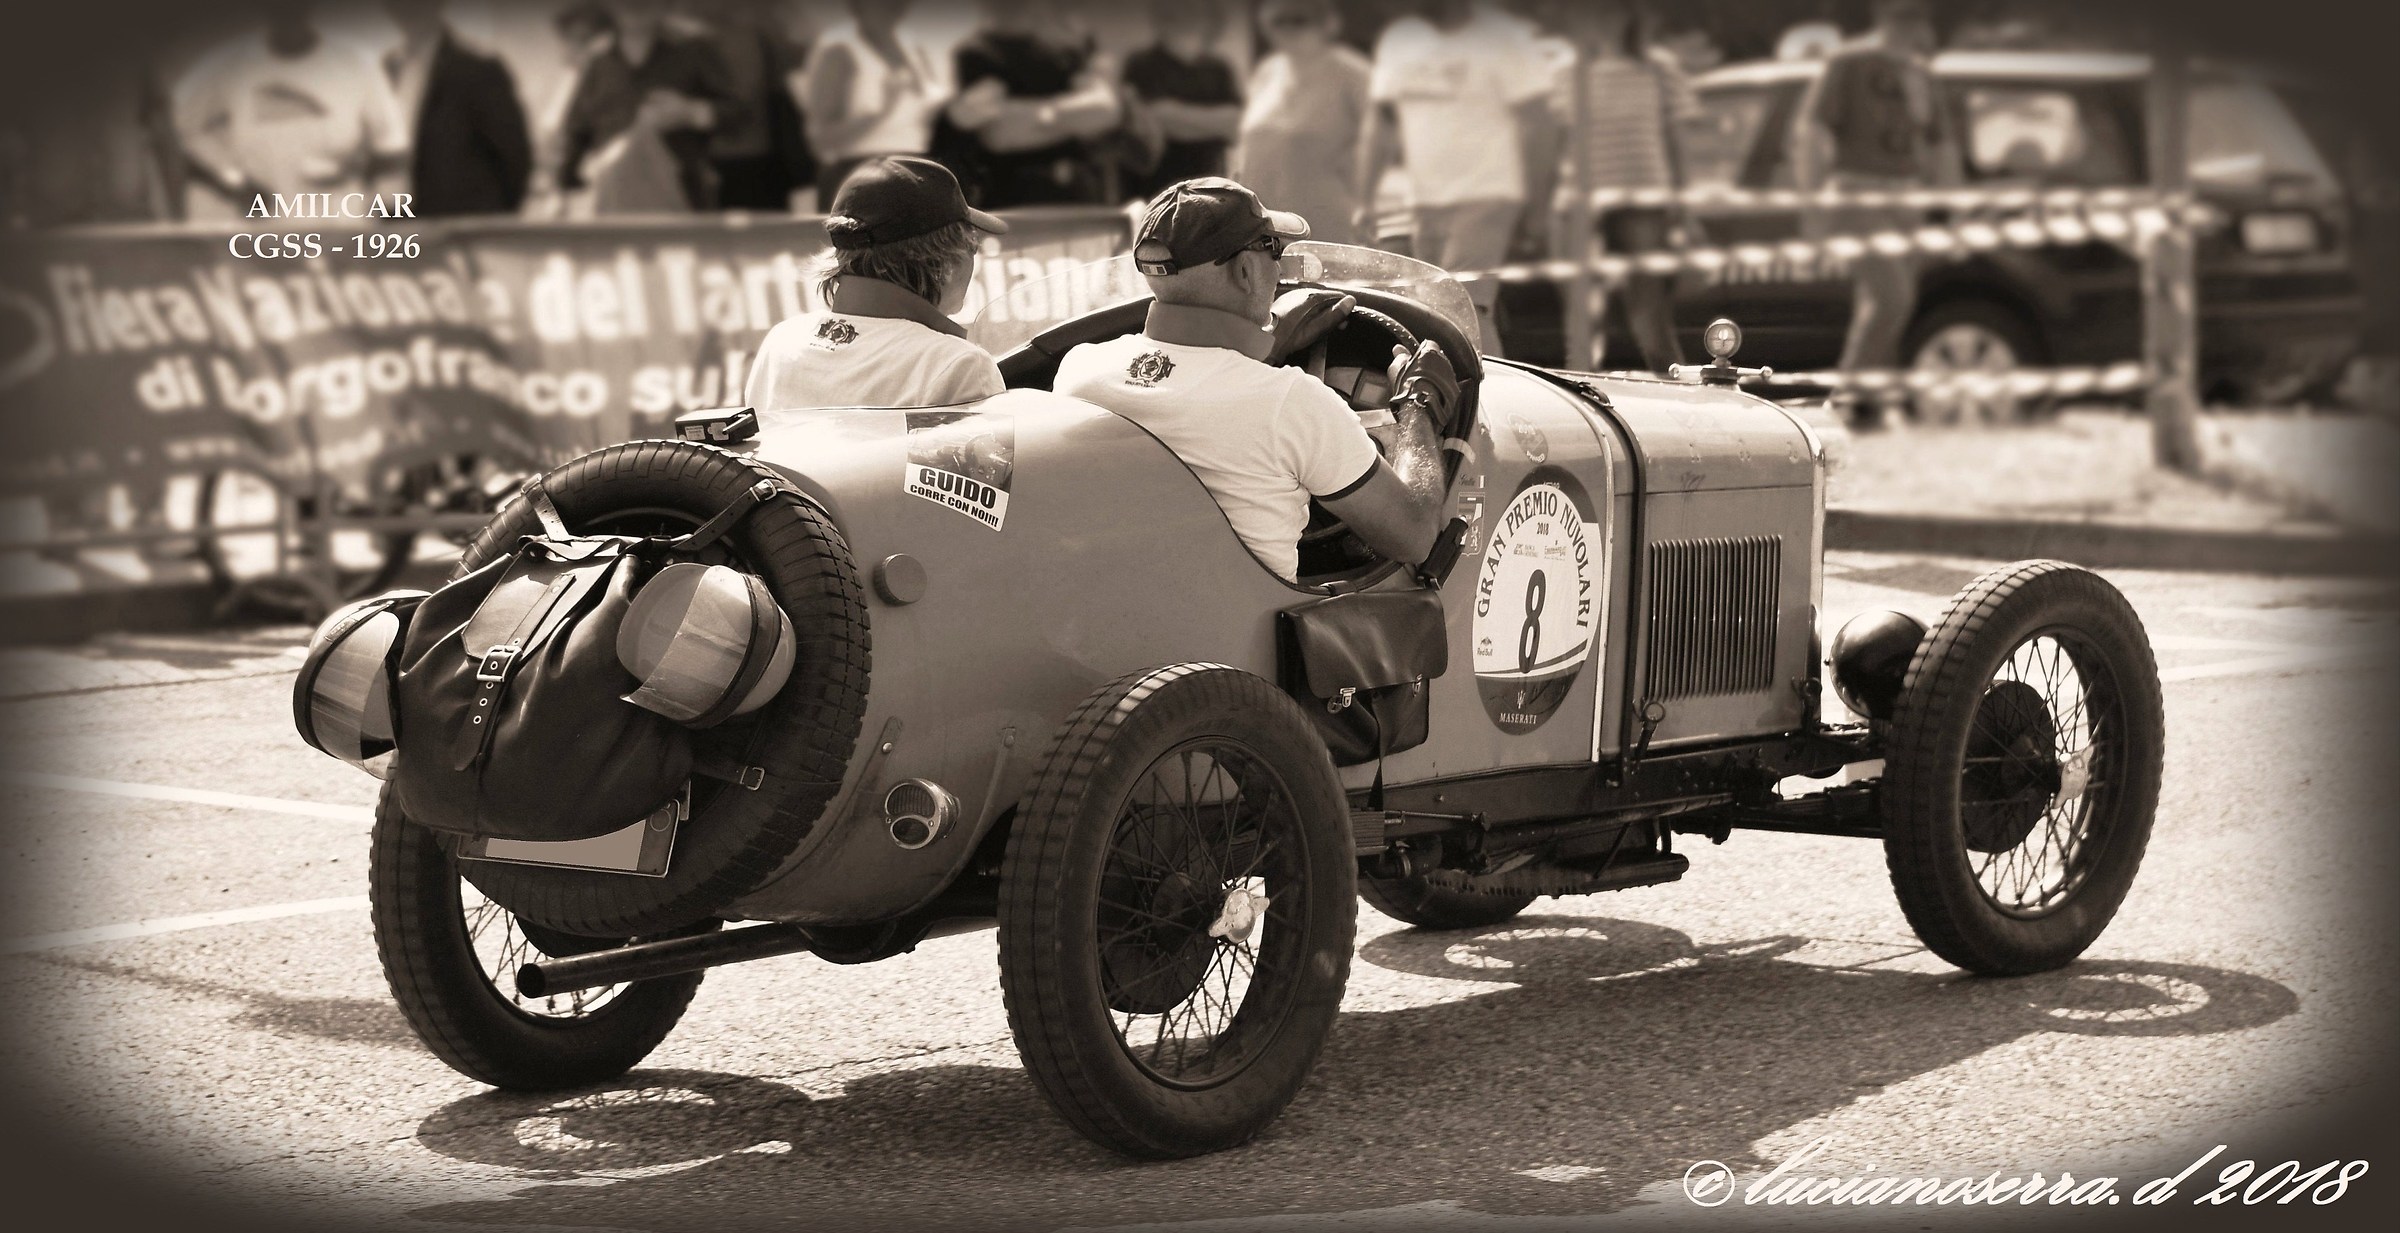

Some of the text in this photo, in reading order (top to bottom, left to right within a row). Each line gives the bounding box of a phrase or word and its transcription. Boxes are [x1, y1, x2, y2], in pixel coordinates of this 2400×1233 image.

[192, 252, 515, 352] Nazionae
[530, 249, 648, 342] del
[137, 355, 208, 412] di
[910, 484, 999, 528] CORRE CON NOI!!!
[919, 467, 997, 510] GUIDO
[1536, 522, 1550, 536] 2018
[1477, 491, 1591, 628] GRAN PREMIO NUVOLARI
[1518, 568, 1547, 674] 8
[1499, 712, 1537, 725] MASERATI
